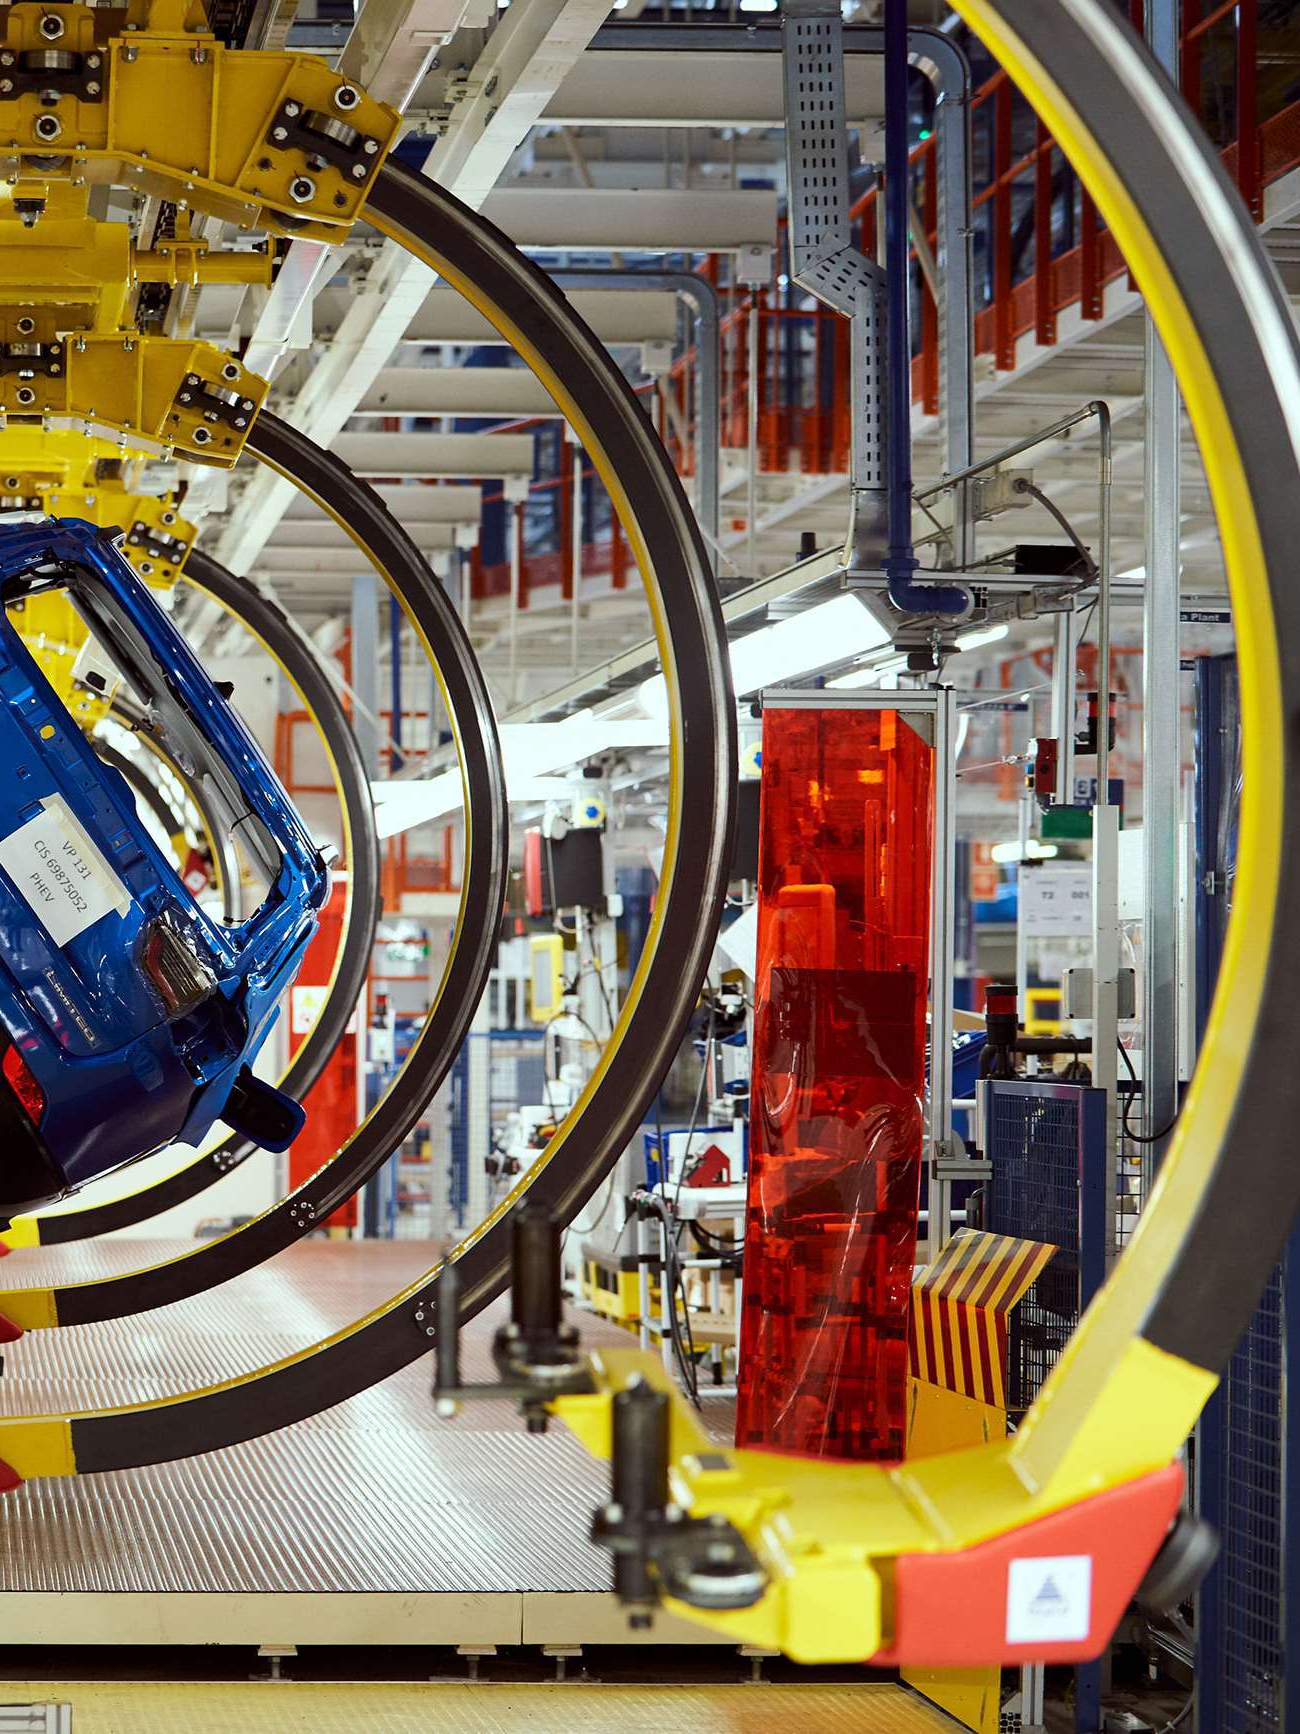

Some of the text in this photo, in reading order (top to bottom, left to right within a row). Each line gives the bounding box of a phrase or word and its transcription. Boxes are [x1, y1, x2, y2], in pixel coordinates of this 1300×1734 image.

[1191, 613, 1220, 621] Plant
[34, 840, 88, 913] CIS 69875052
[62, 840, 92, 880] VP 131
[29, 872, 55, 903] PHEV
